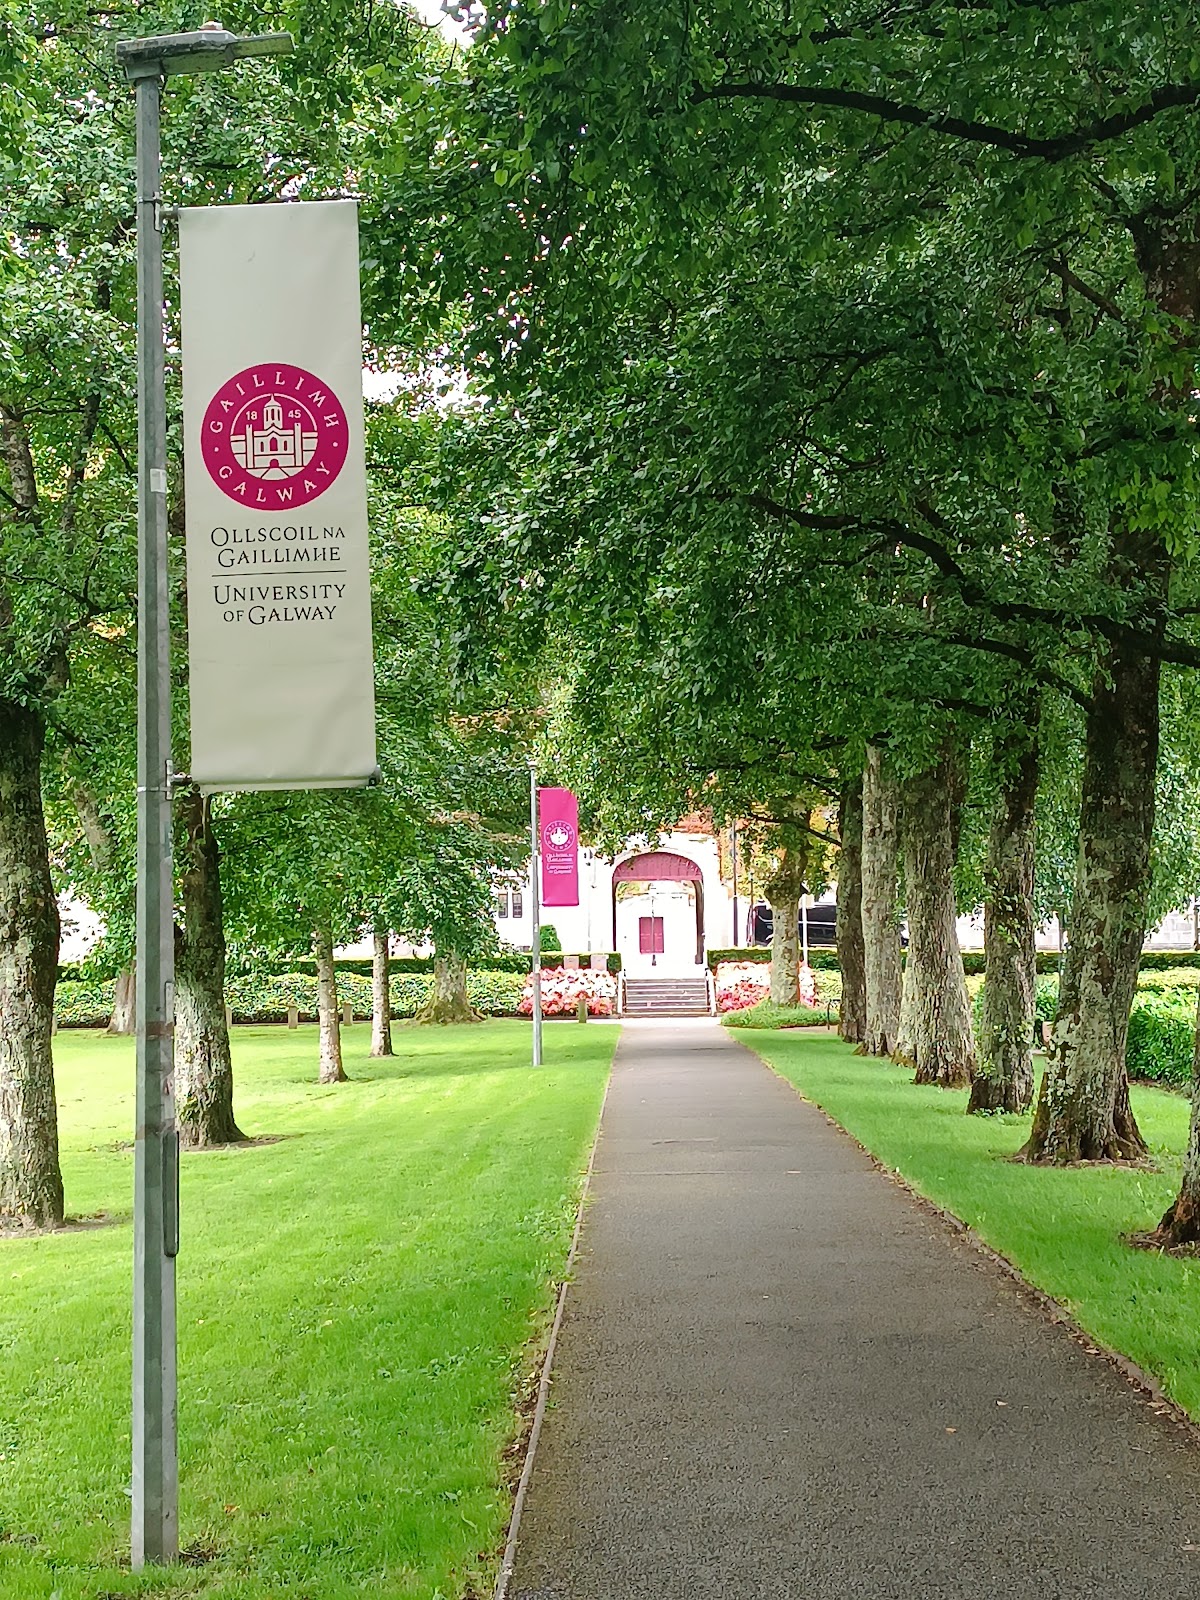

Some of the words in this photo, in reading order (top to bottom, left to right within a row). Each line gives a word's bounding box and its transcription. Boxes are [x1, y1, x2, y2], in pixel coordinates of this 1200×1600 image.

[209, 371, 339, 433] GAILLIMH
[218, 461, 330, 503] GALWAY
[210, 526, 319, 547] OLLSCOIL
[323, 526, 346, 539] NA
[217, 546, 341, 568] GAILLIMHE
[213, 584, 346, 605] UNIVERSITY
[248, 605, 337, 625] GALWAY
